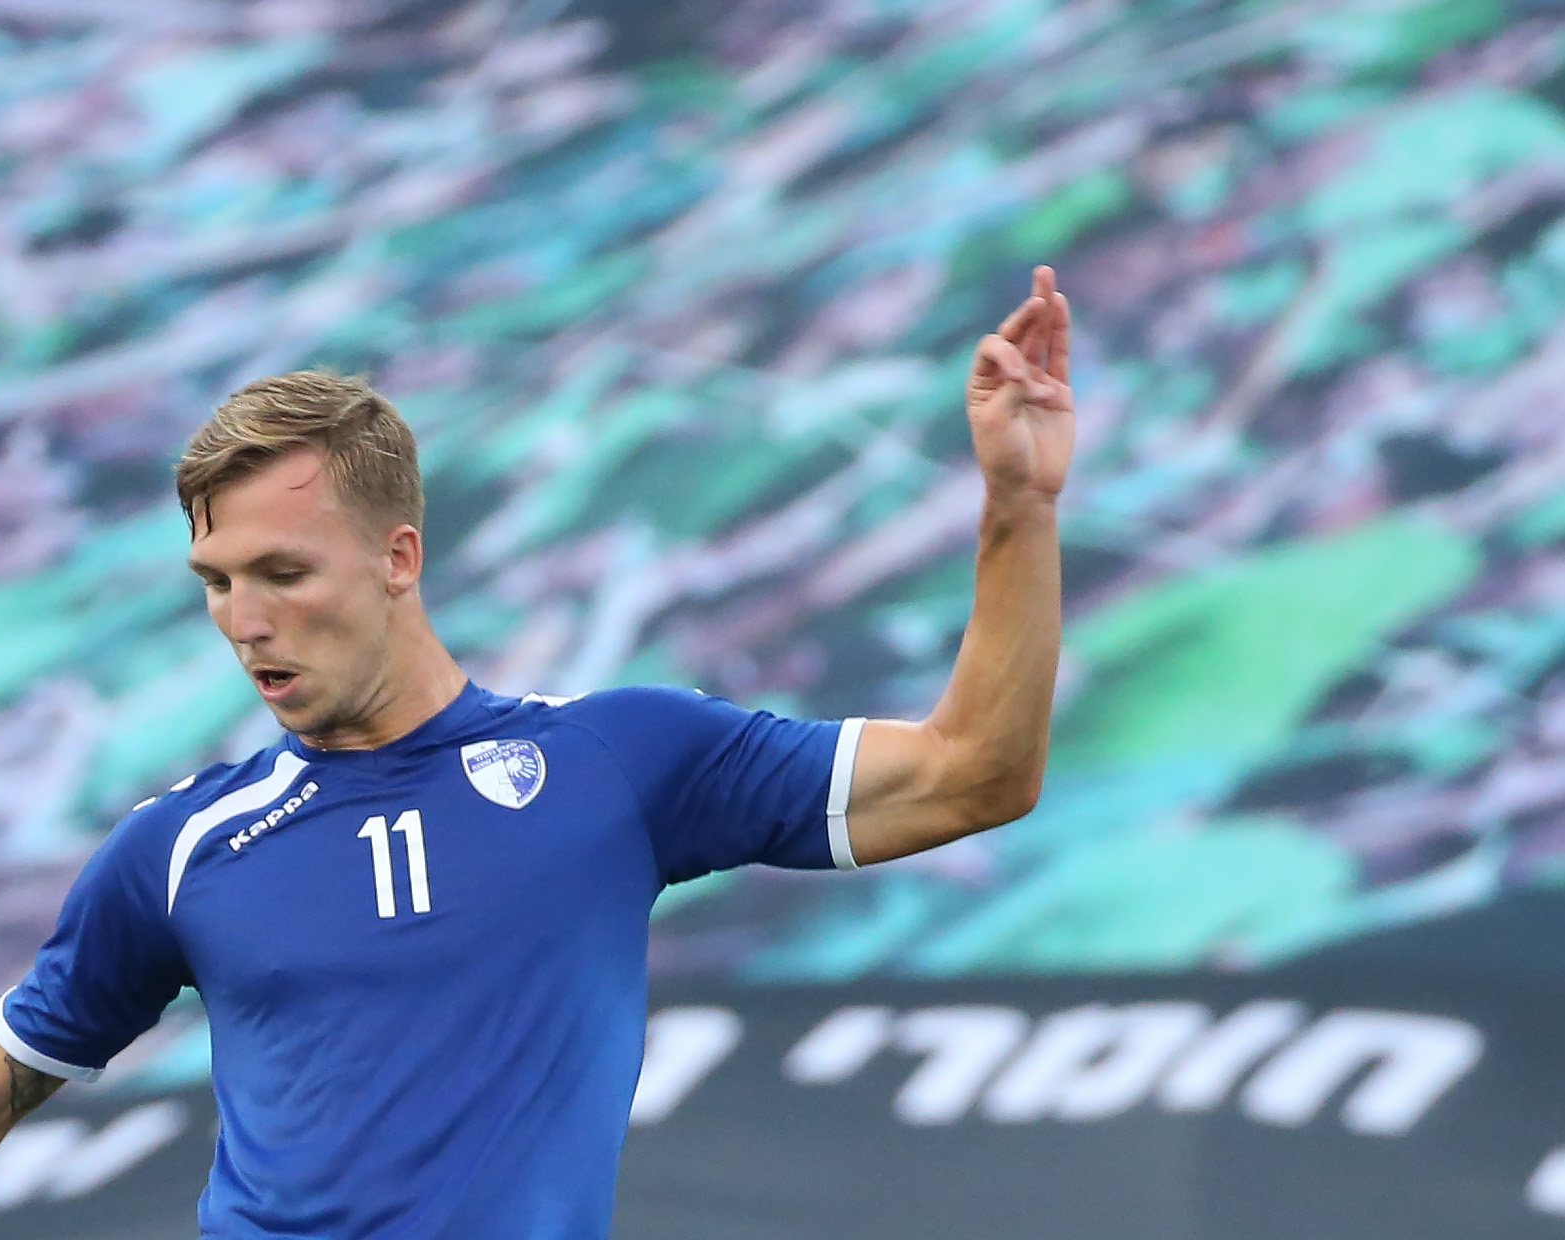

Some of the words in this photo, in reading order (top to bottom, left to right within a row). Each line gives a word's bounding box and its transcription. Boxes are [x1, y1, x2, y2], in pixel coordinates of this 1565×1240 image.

[228, 780, 321, 852] Kappa
[356, 808, 433, 920] 11
[782, 998, 1486, 1140] חומרי
